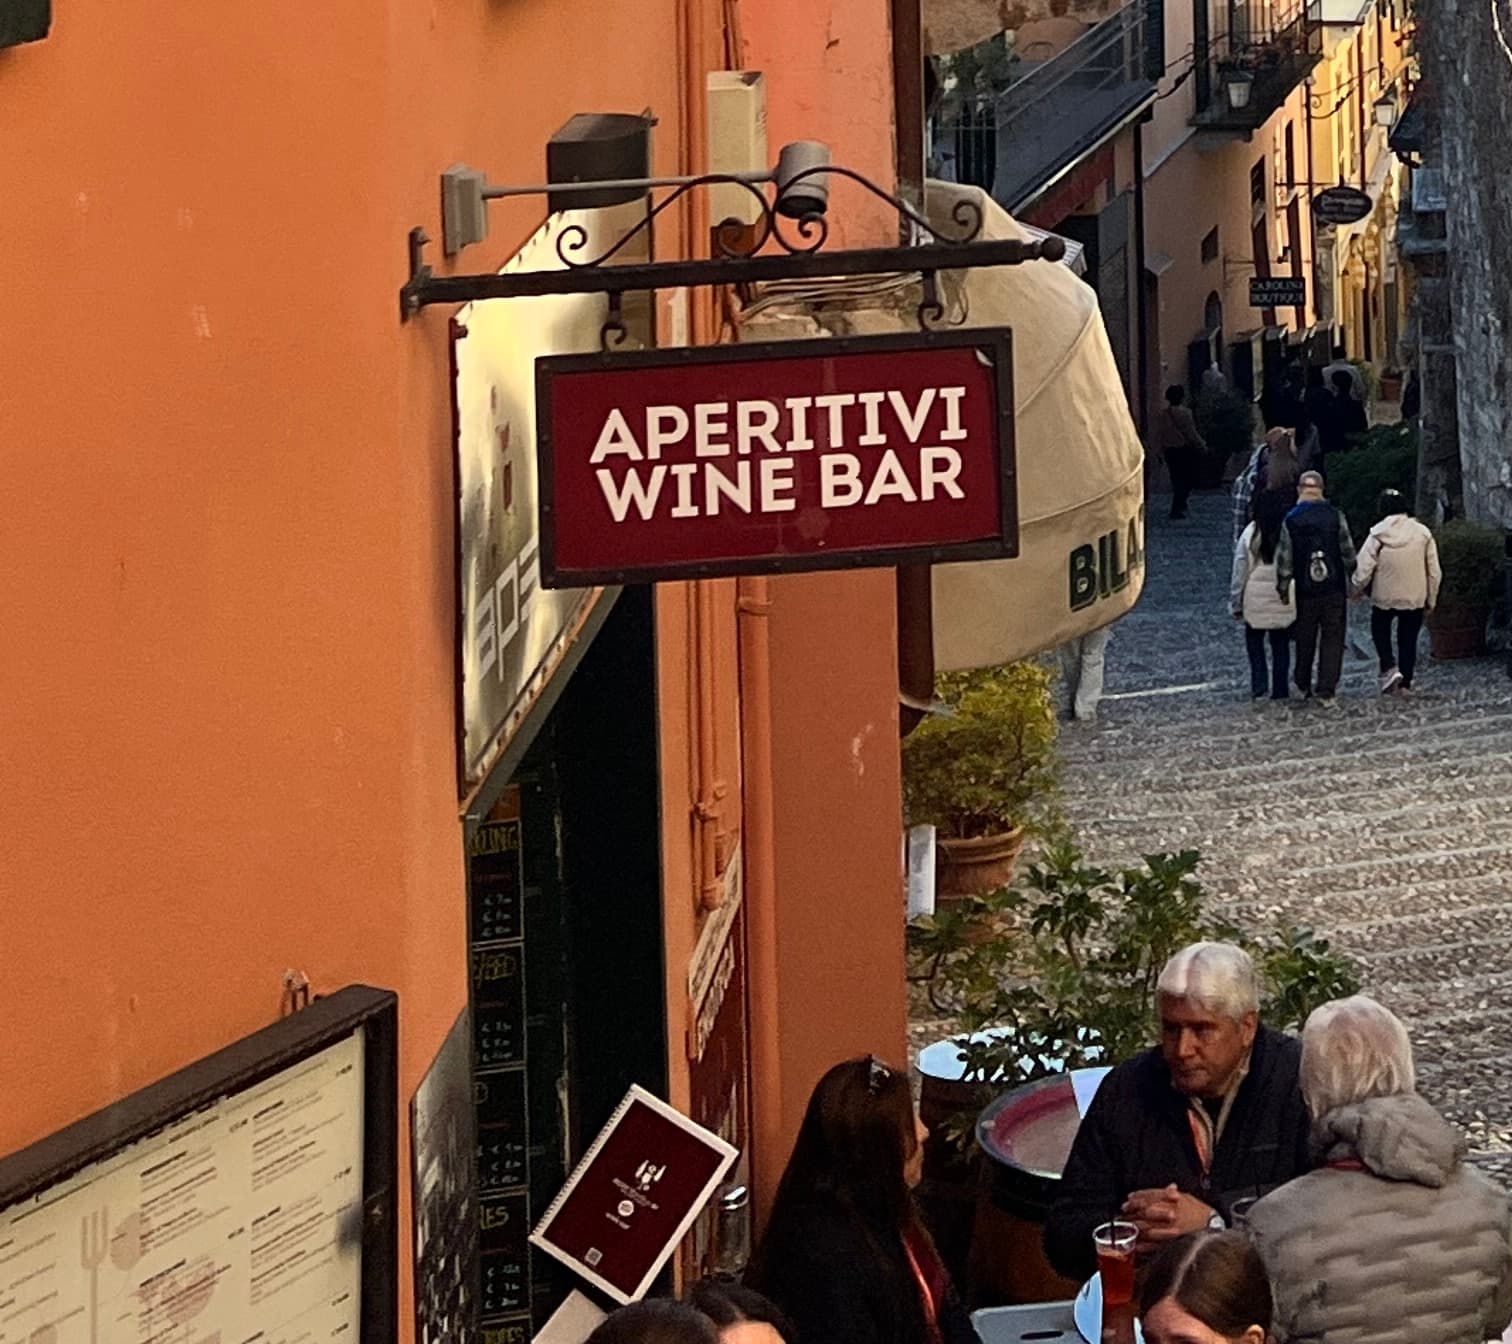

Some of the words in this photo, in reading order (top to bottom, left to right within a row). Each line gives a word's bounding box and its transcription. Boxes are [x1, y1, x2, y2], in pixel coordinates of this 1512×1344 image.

[589, 386, 968, 464] APERITIVI
[595, 457, 796, 523] WINE
[820, 446, 966, 509] BAR
